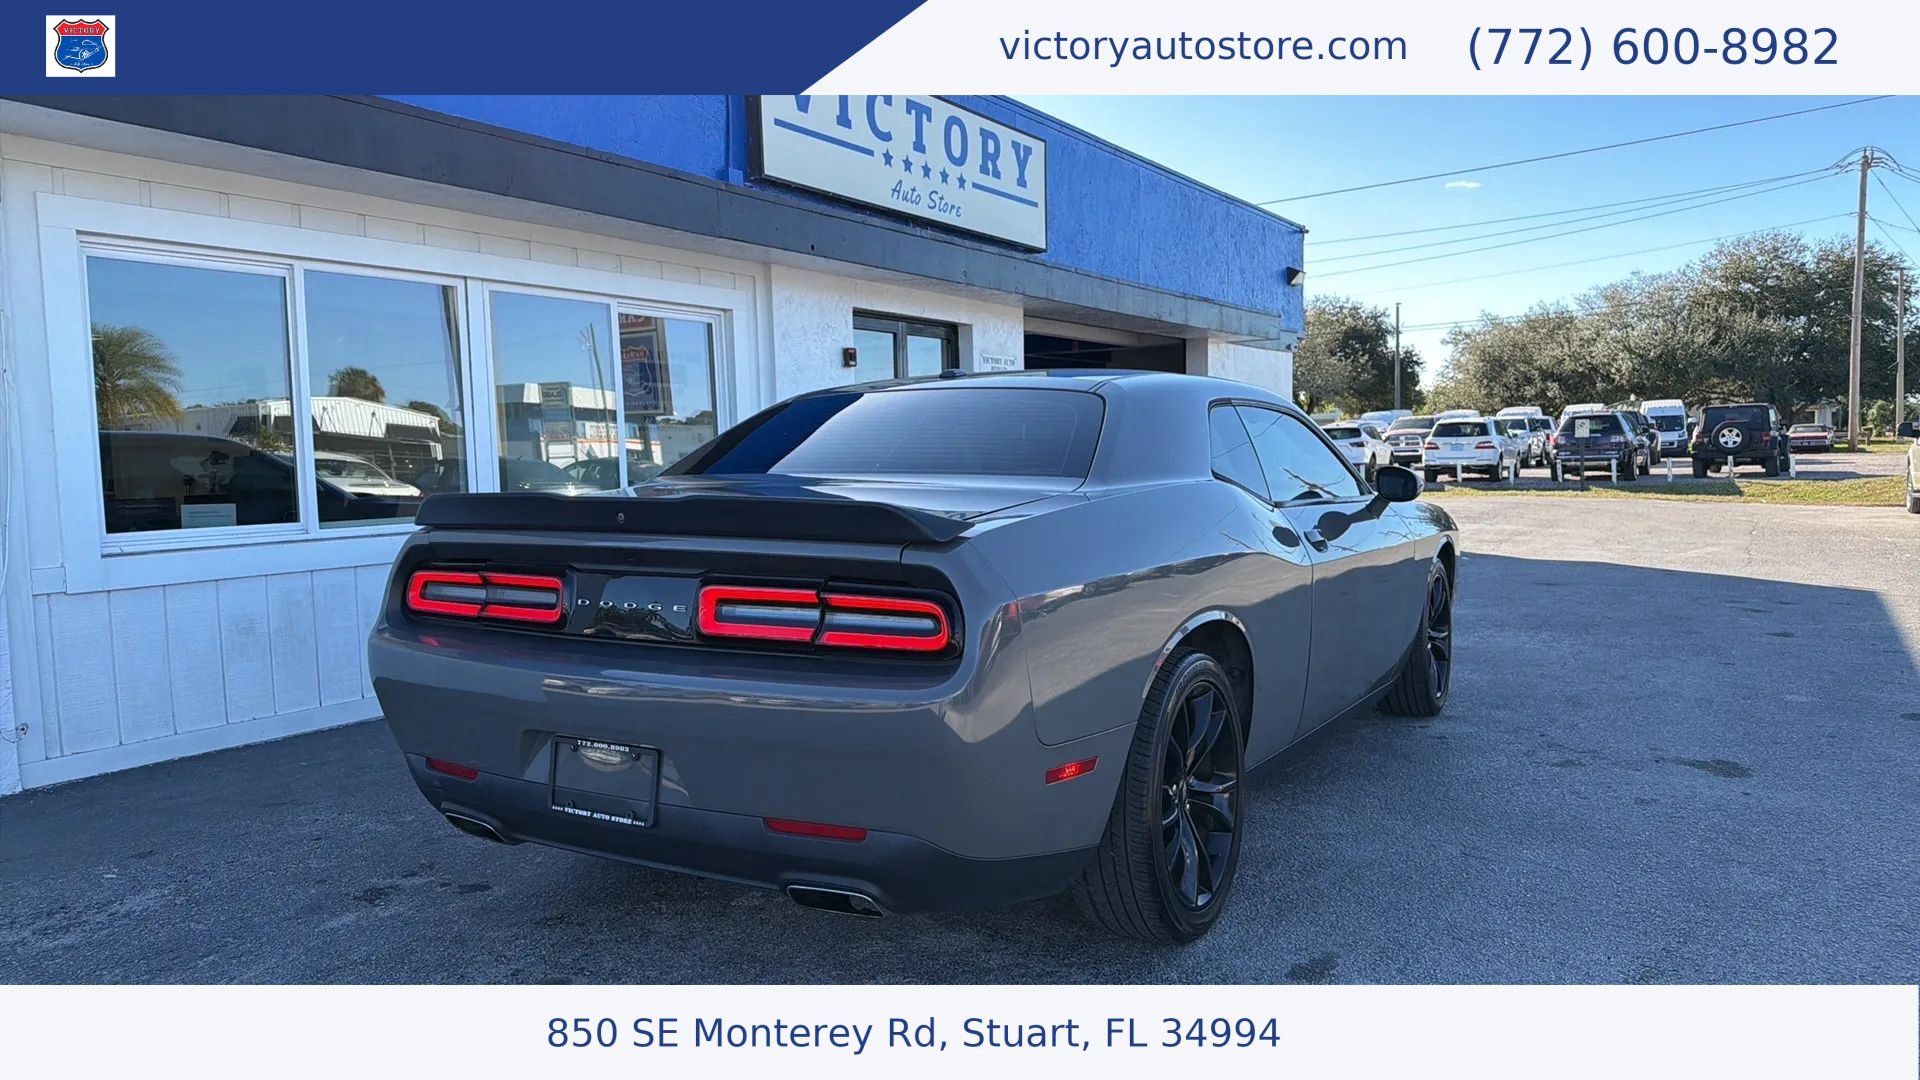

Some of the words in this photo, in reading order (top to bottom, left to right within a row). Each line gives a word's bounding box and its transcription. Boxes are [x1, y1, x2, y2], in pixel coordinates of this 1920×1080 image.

[891, 179, 921, 206] Auto
[928, 191, 962, 218] Store
[577, 599, 687, 613] DODGE
[564, 807, 592, 817] VICTORY
[592, 812, 610, 821] AUTO
[611, 815, 632, 825] STORE
